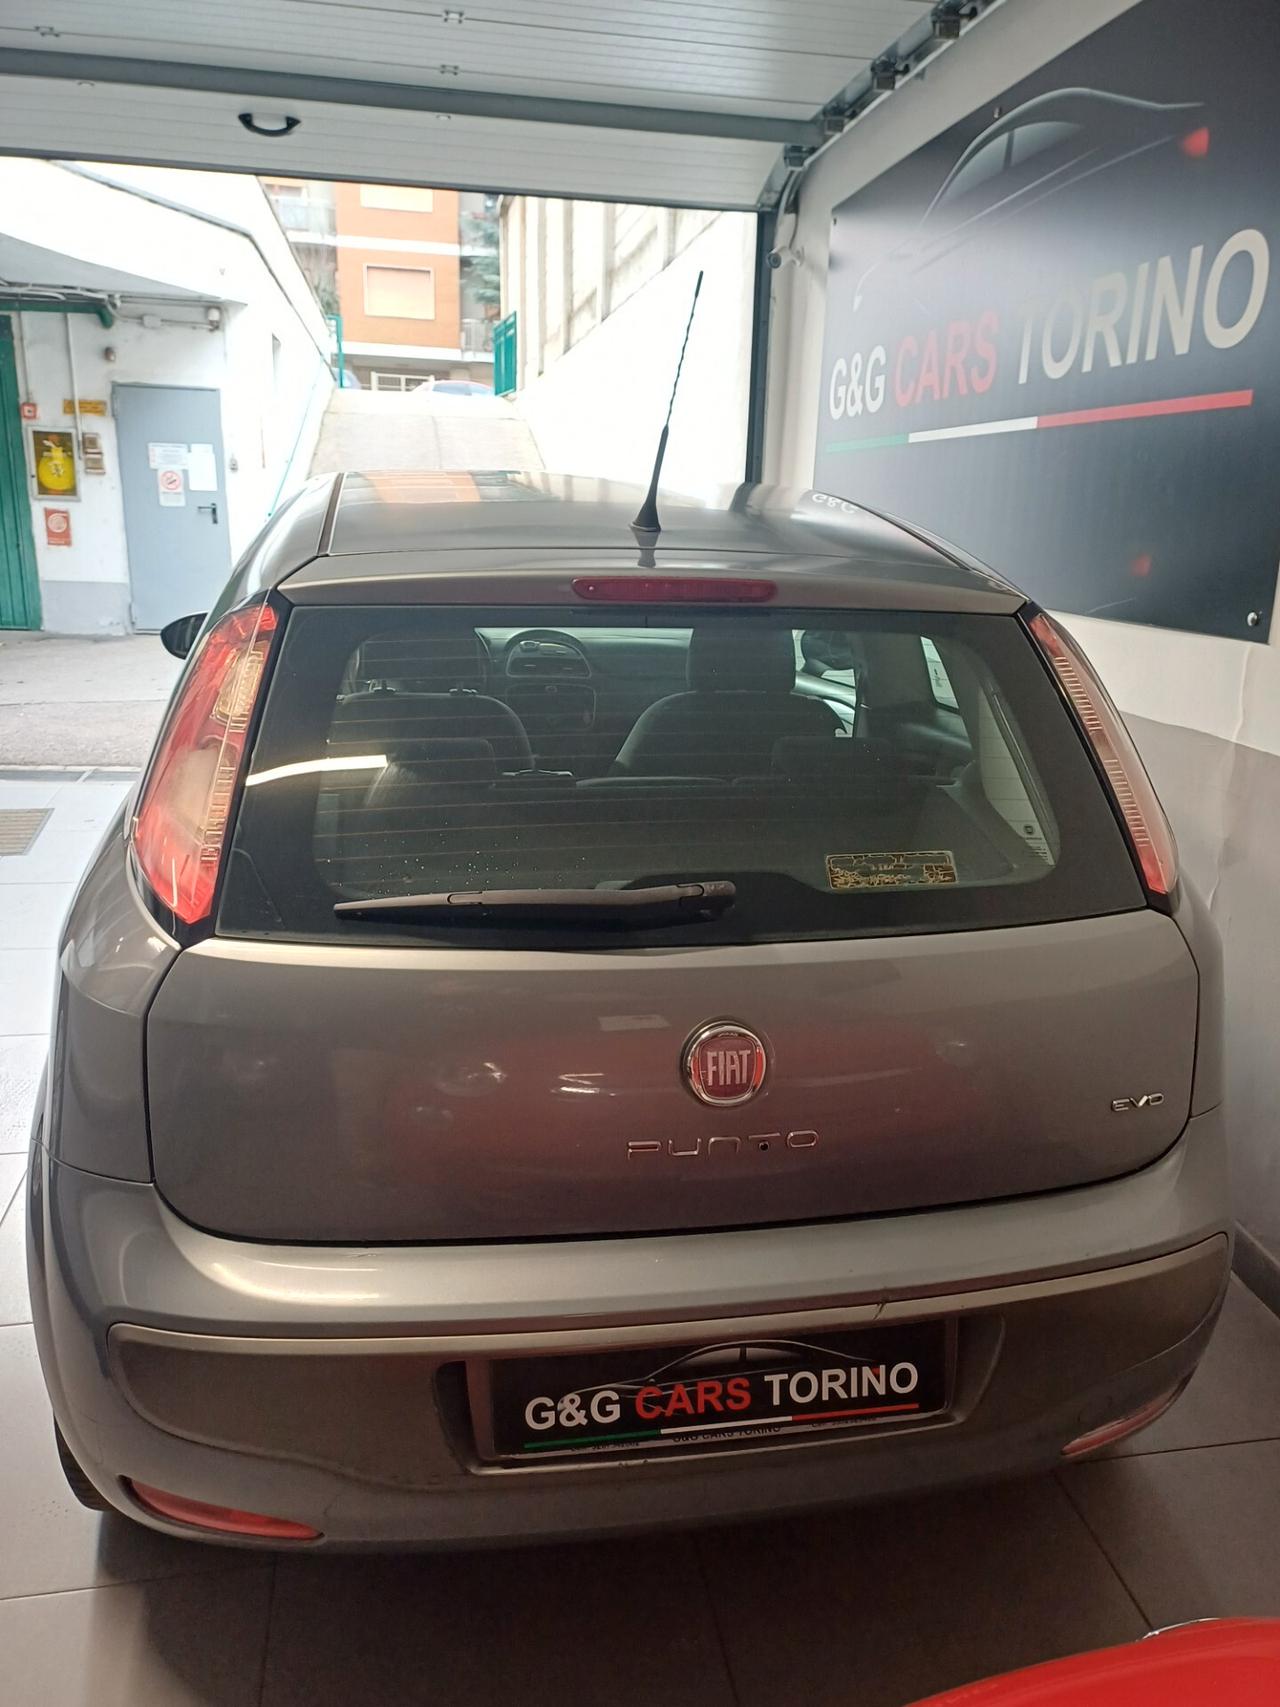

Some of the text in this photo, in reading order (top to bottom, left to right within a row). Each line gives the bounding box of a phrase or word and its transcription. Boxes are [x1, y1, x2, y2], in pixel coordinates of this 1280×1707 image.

[829, 229, 1270, 420] G&G CARS TORINO
[707, 1049, 751, 1086] FIAT
[1111, 1092, 1165, 1112] EVO
[627, 1129, 819, 1161] PUNTO
[524, 1362, 919, 1431] G&G CARS TORINO
